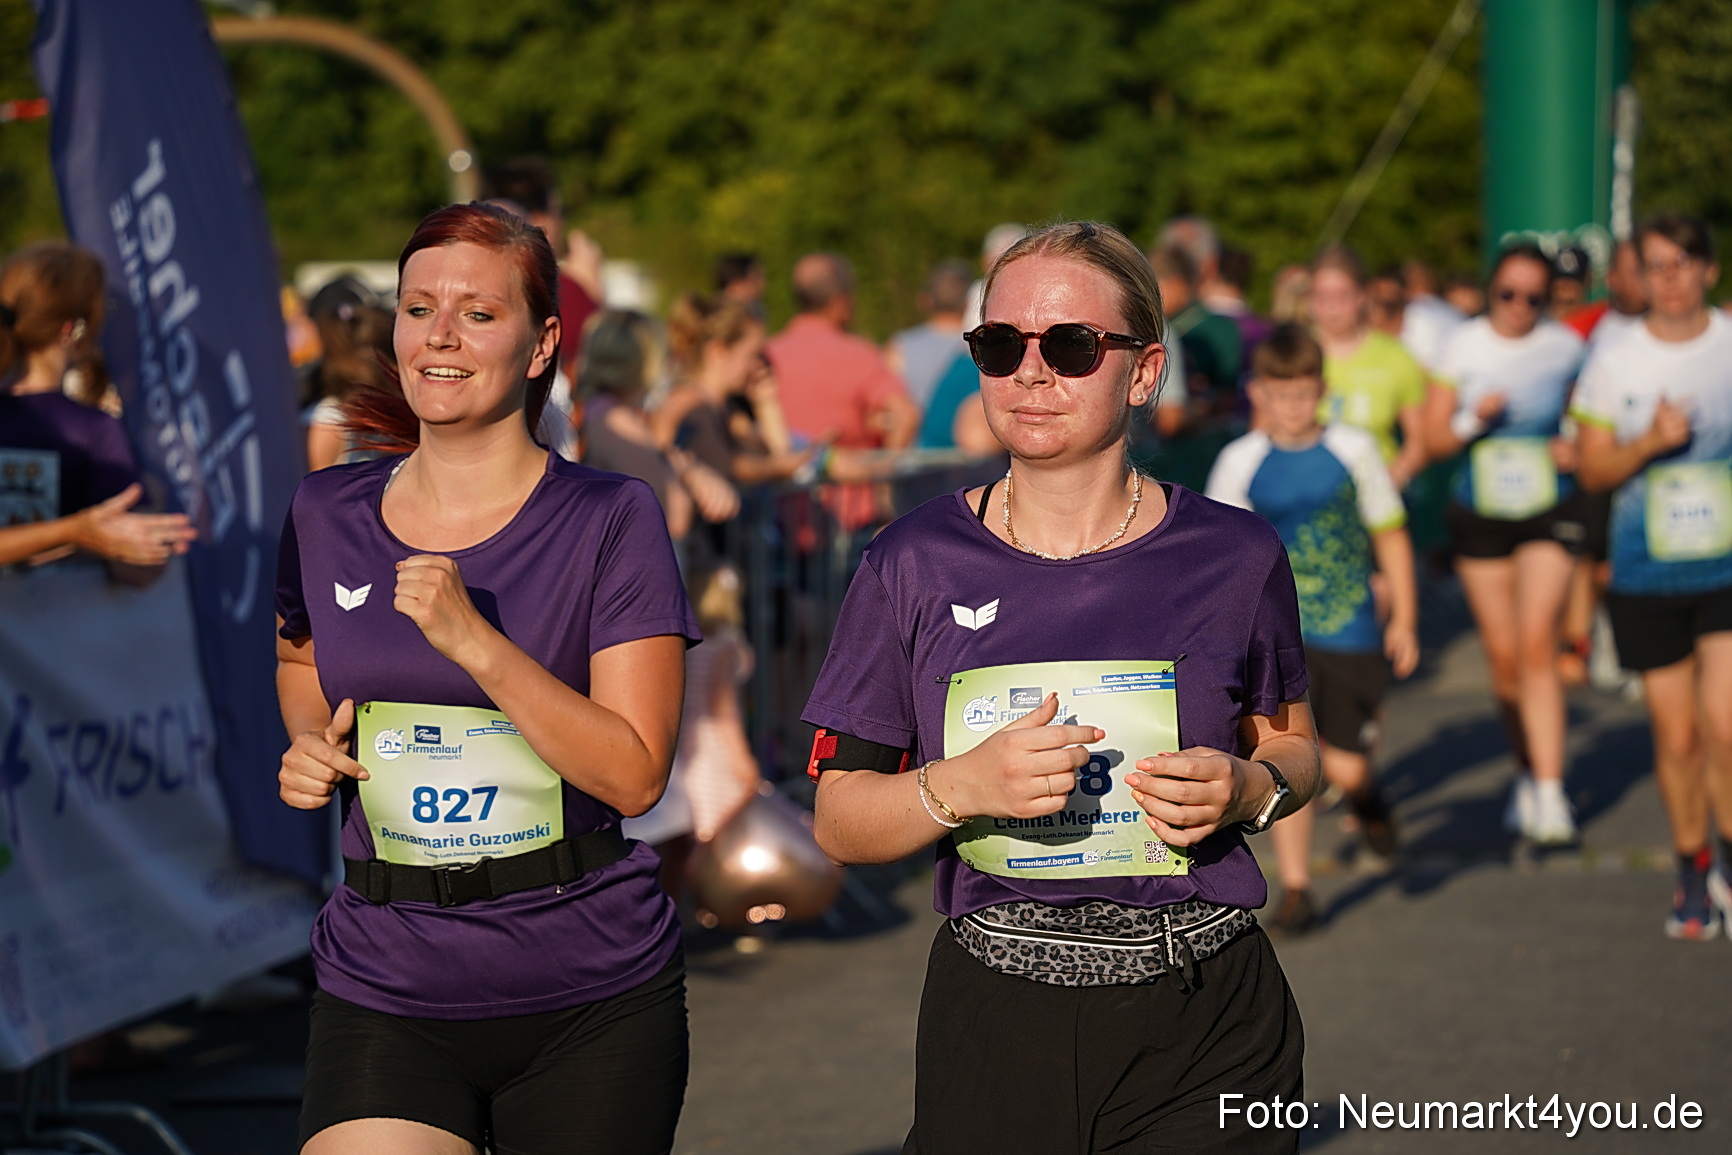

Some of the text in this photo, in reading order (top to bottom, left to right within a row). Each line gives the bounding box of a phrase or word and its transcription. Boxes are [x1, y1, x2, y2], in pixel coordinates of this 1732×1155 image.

[1015, 694, 1041, 702] Fischer
[406, 743, 463, 754] Firmenlauf
[412, 785, 499, 824] 827
[1059, 809, 1140, 827] Mederer
[381, 821, 551, 849] Annamarie Guzowski
[1084, 829, 1115, 837] Neumarkt
[1010, 856, 1080, 868] firmenlauf.bayern
